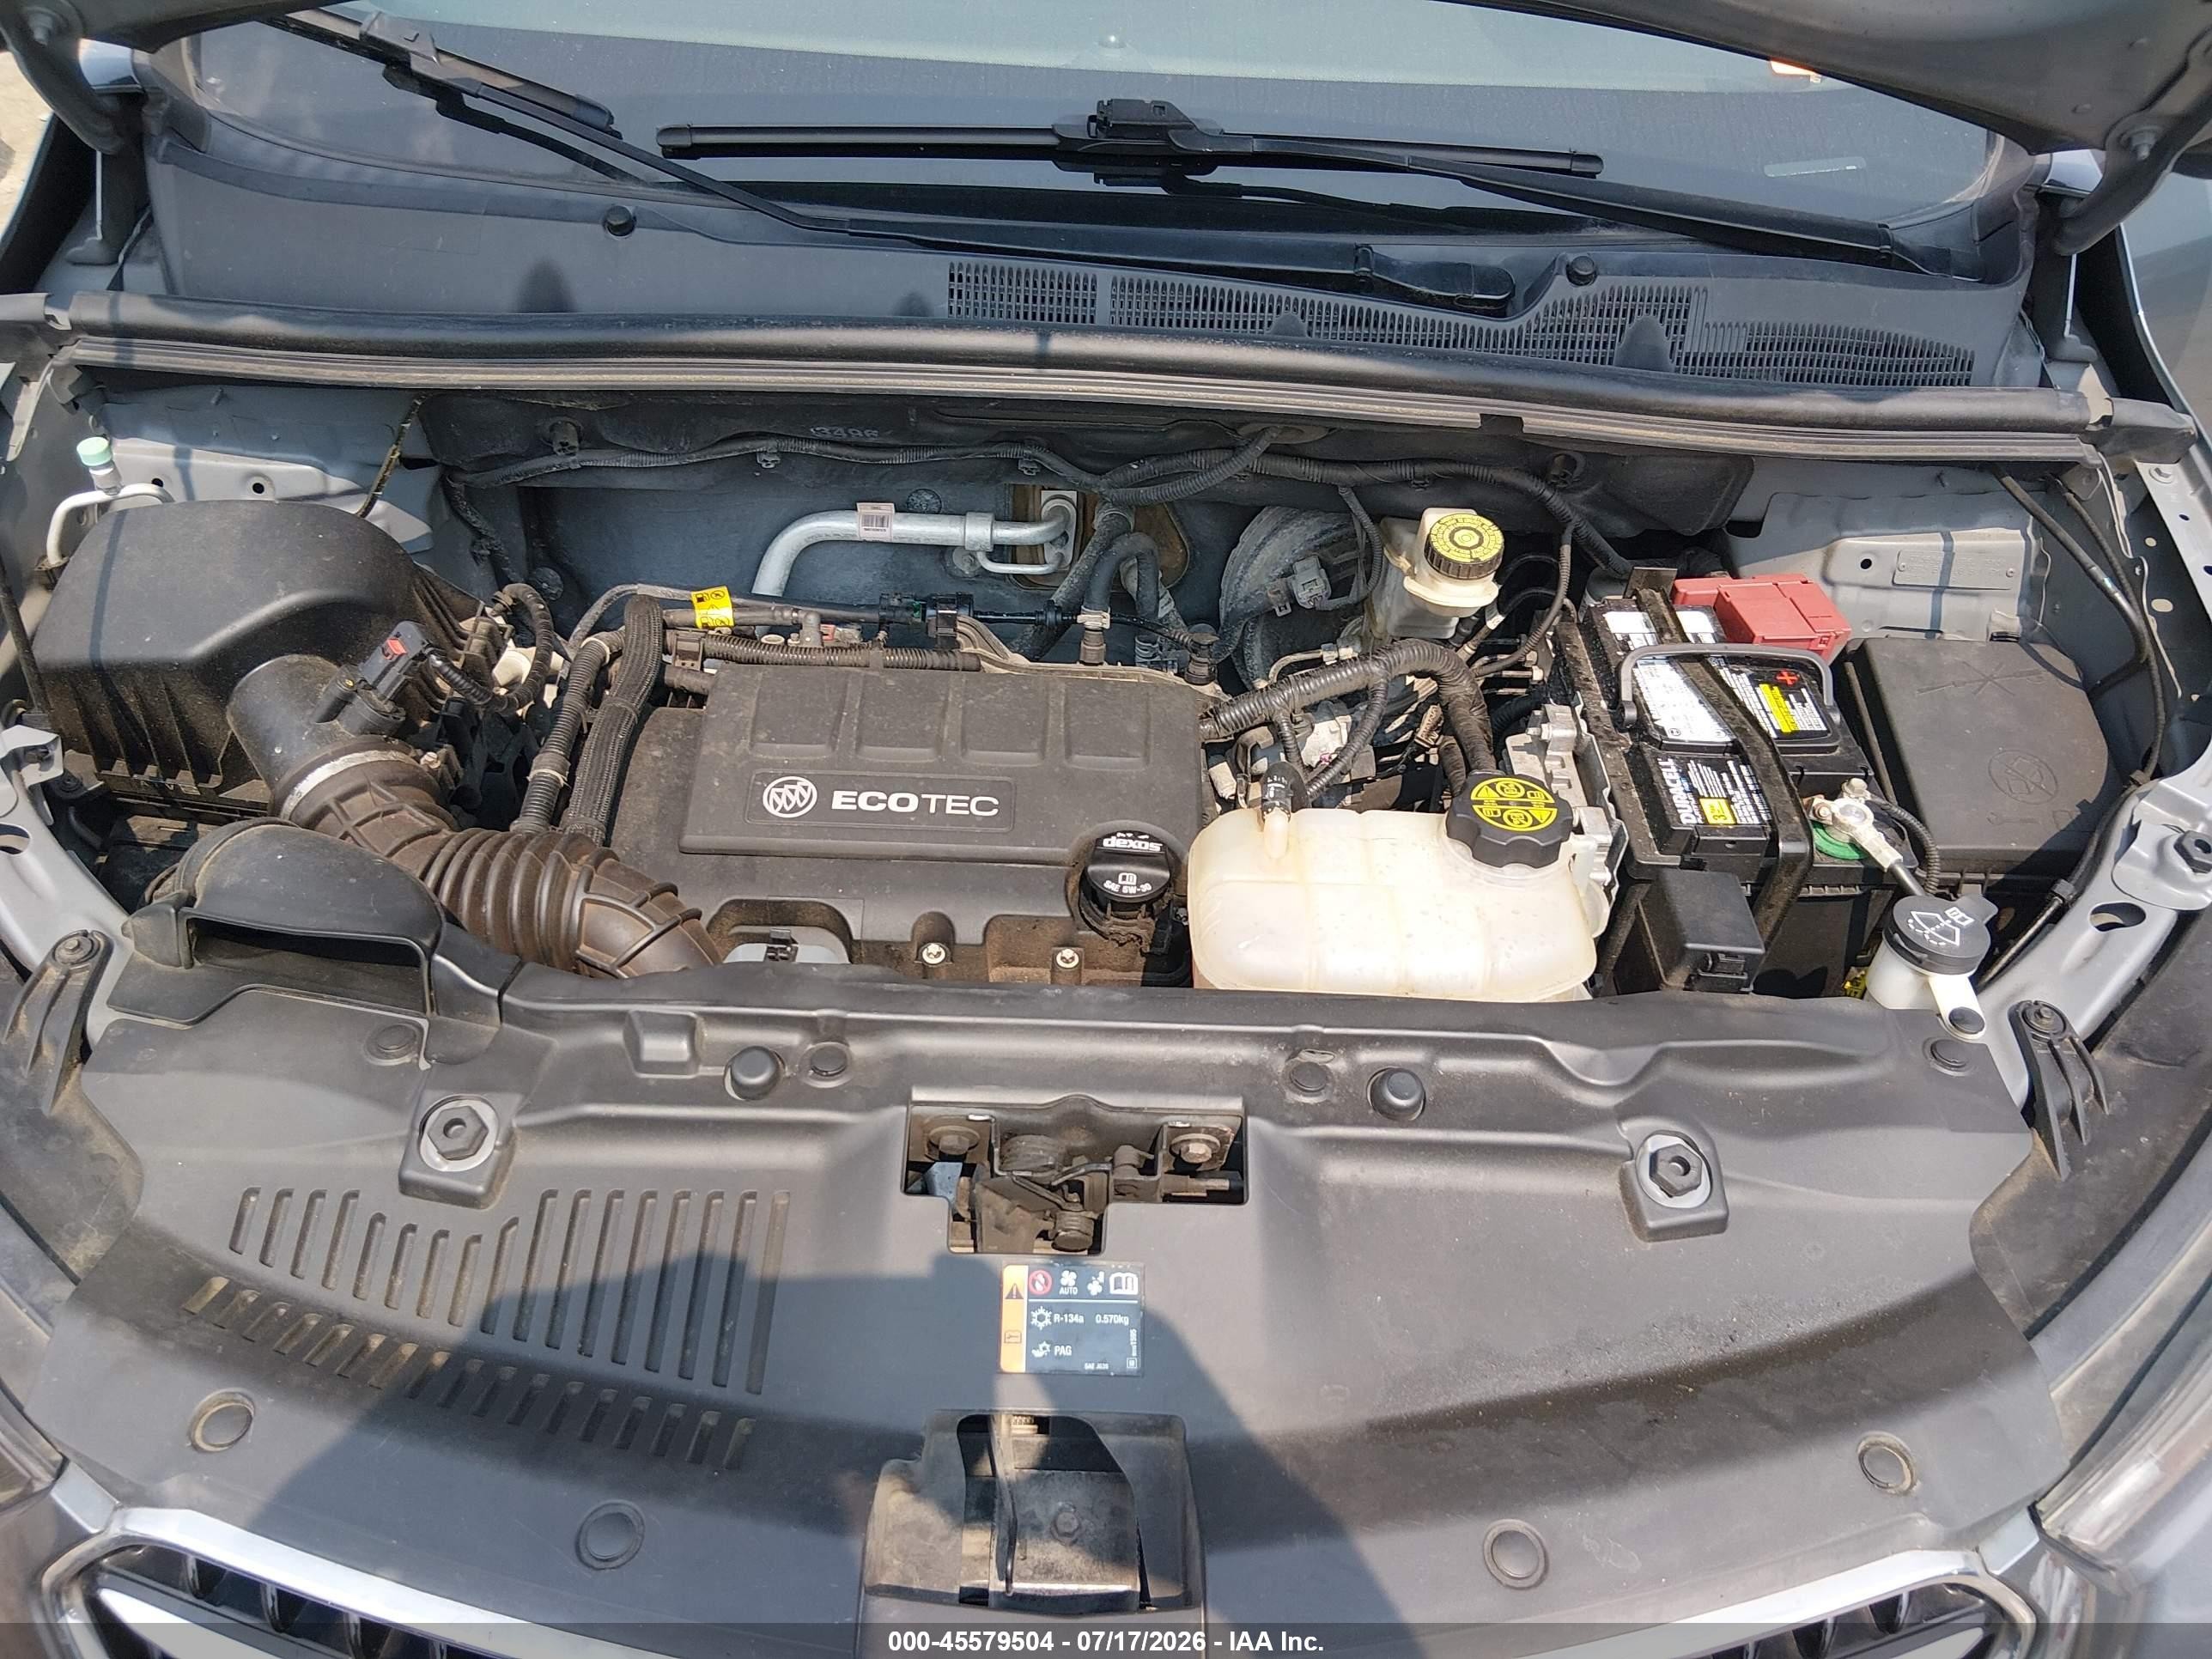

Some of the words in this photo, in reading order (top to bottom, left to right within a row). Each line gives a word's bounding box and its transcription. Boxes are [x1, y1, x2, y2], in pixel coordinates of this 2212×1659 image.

[1657, 758, 1698, 824] DURACELL
[831, 790, 1000, 816] ECOTEC
[1103, 836, 1164, 851] dexos
[1103, 880, 1121, 892] SAE
[1121, 883, 1152, 893] 5W-30
[1054, 1314, 1085, 1323] R-134a
[1095, 1314, 1129, 1326] 0.570kg
[1054, 1346, 1073, 1356] PAG
